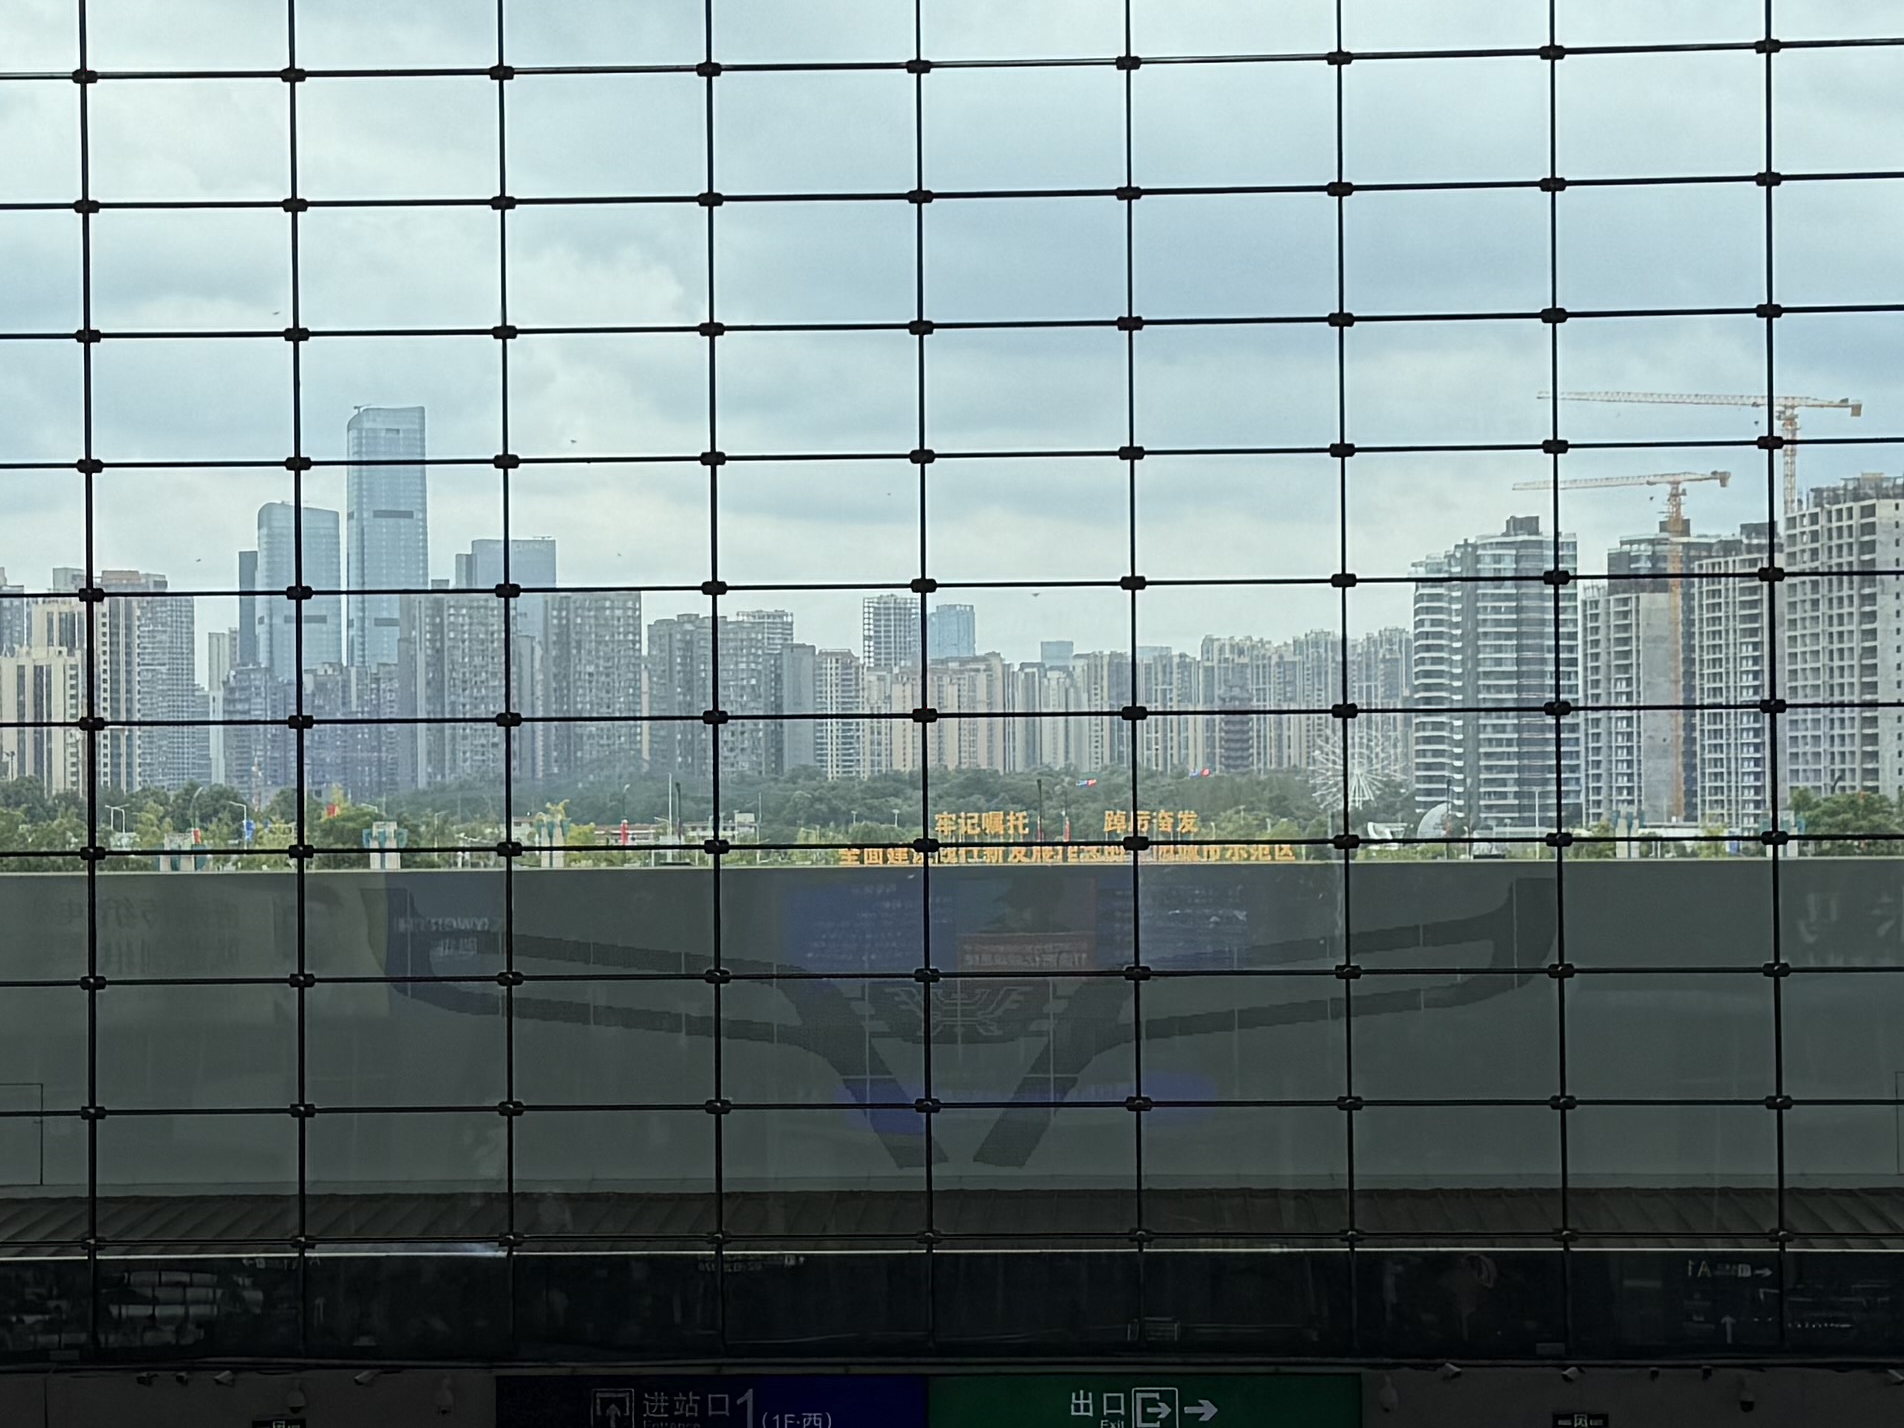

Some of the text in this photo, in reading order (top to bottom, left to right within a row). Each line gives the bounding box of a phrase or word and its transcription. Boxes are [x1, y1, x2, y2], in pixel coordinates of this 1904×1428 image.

[934, 811, 1030, 836] 牢记嘱托
[1070, 1389, 1125, 1417] 出口
